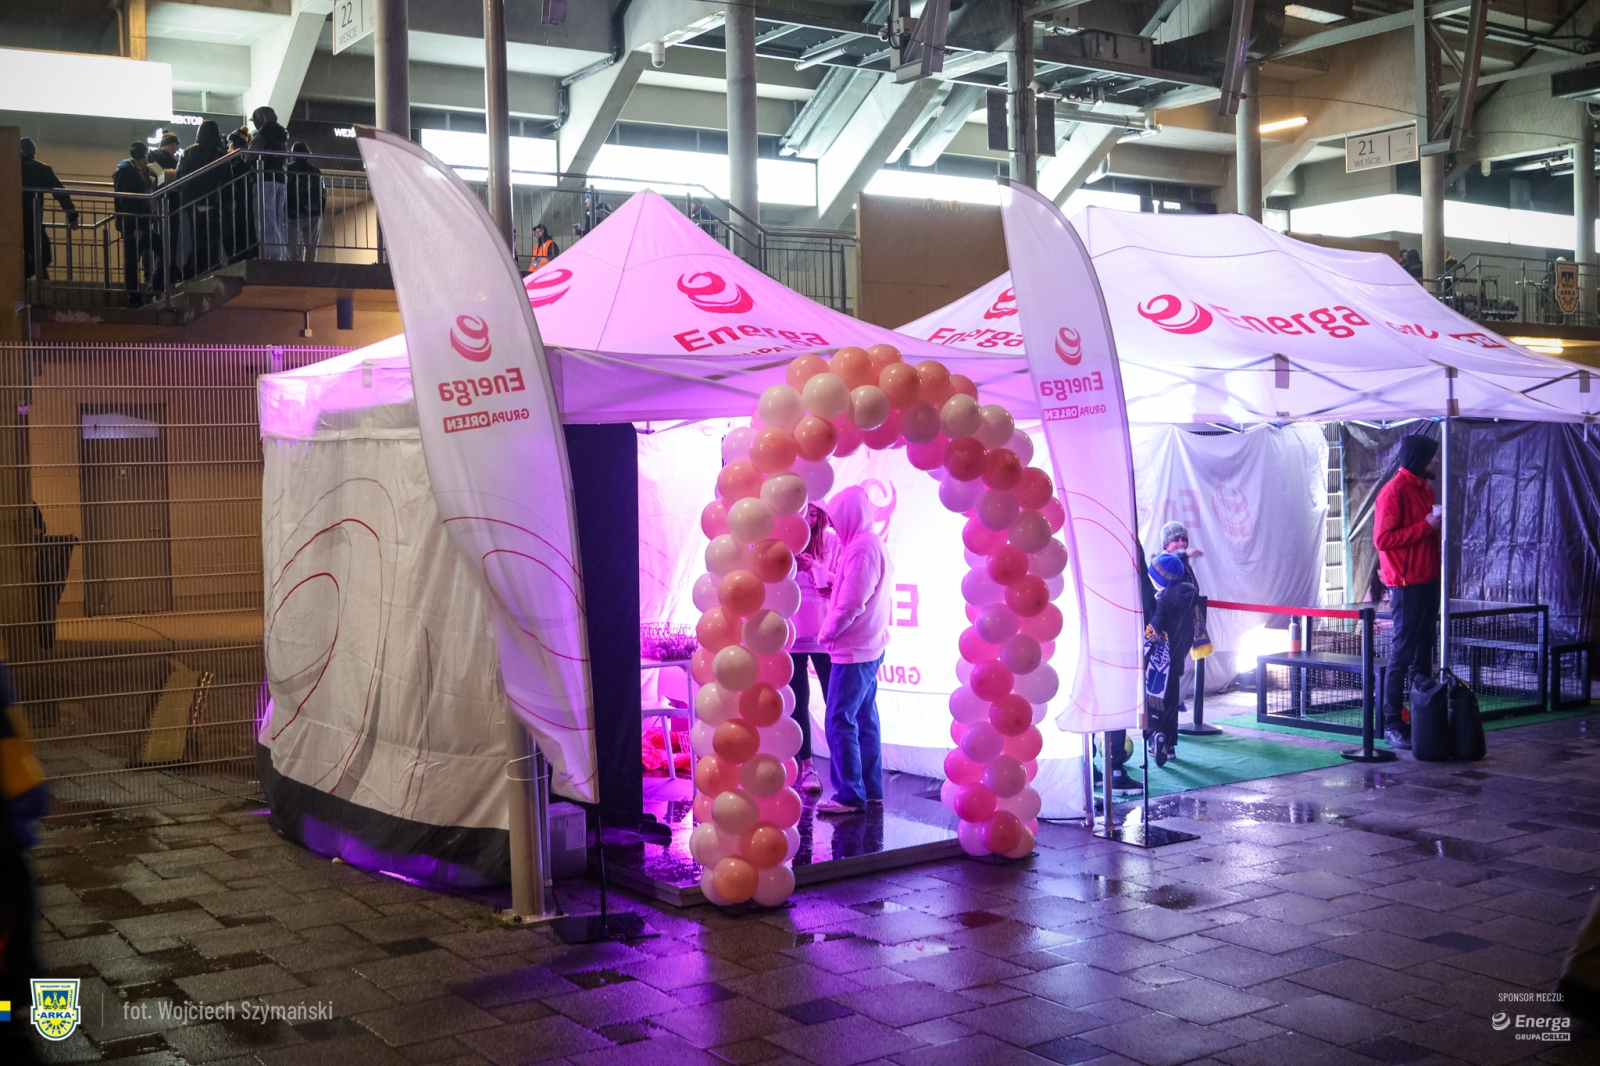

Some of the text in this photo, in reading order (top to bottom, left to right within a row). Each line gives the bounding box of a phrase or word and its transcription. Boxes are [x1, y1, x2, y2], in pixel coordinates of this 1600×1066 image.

[341, 1, 353, 28] 22
[333, 126, 357, 138] WEJŚ
[1358, 138, 1375, 156] 21
[1354, 155, 1383, 168] WEJŚCIE
[1206, 302, 1371, 339] Energa
[673, 324, 831, 353] Energa
